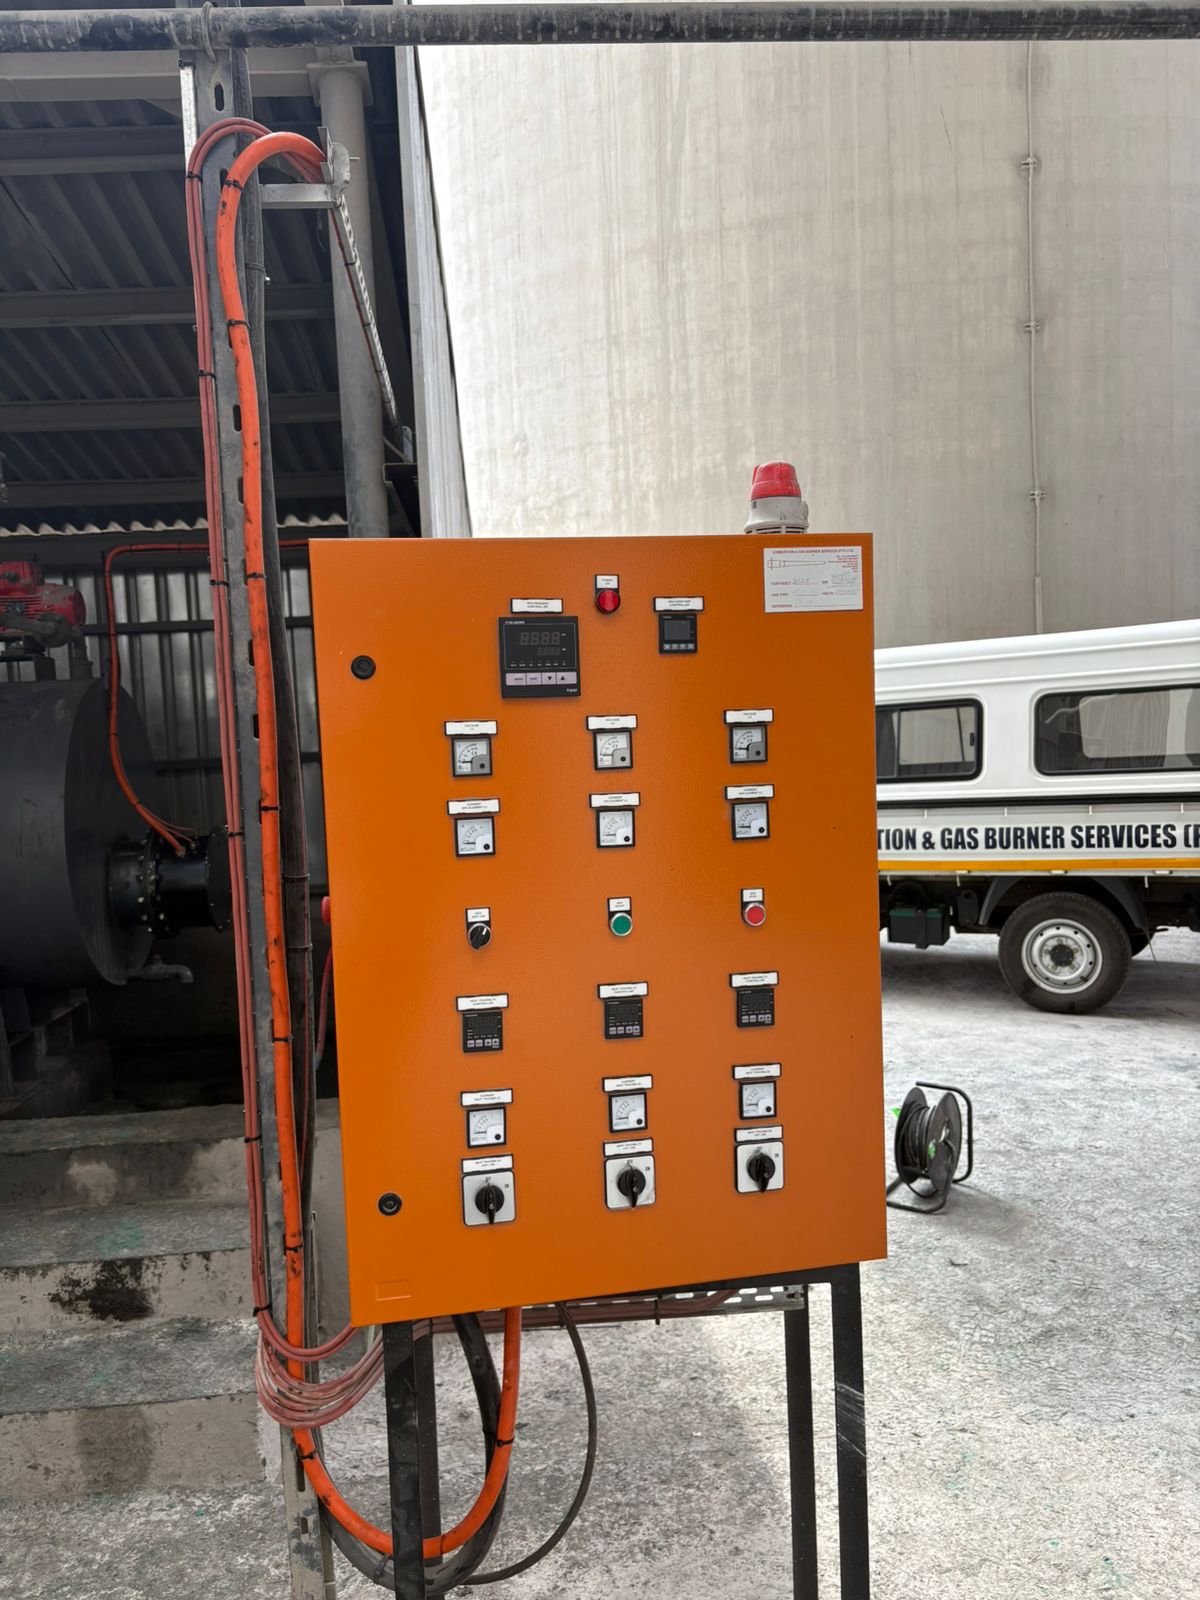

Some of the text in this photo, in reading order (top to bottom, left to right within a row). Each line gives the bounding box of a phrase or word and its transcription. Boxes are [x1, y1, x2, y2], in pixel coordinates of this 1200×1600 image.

[922, 831, 936, 850] &
[940, 827, 979, 850] GAS
[984, 826, 1065, 850] BURNER
[1071, 824, 1177, 849] SERVICES
